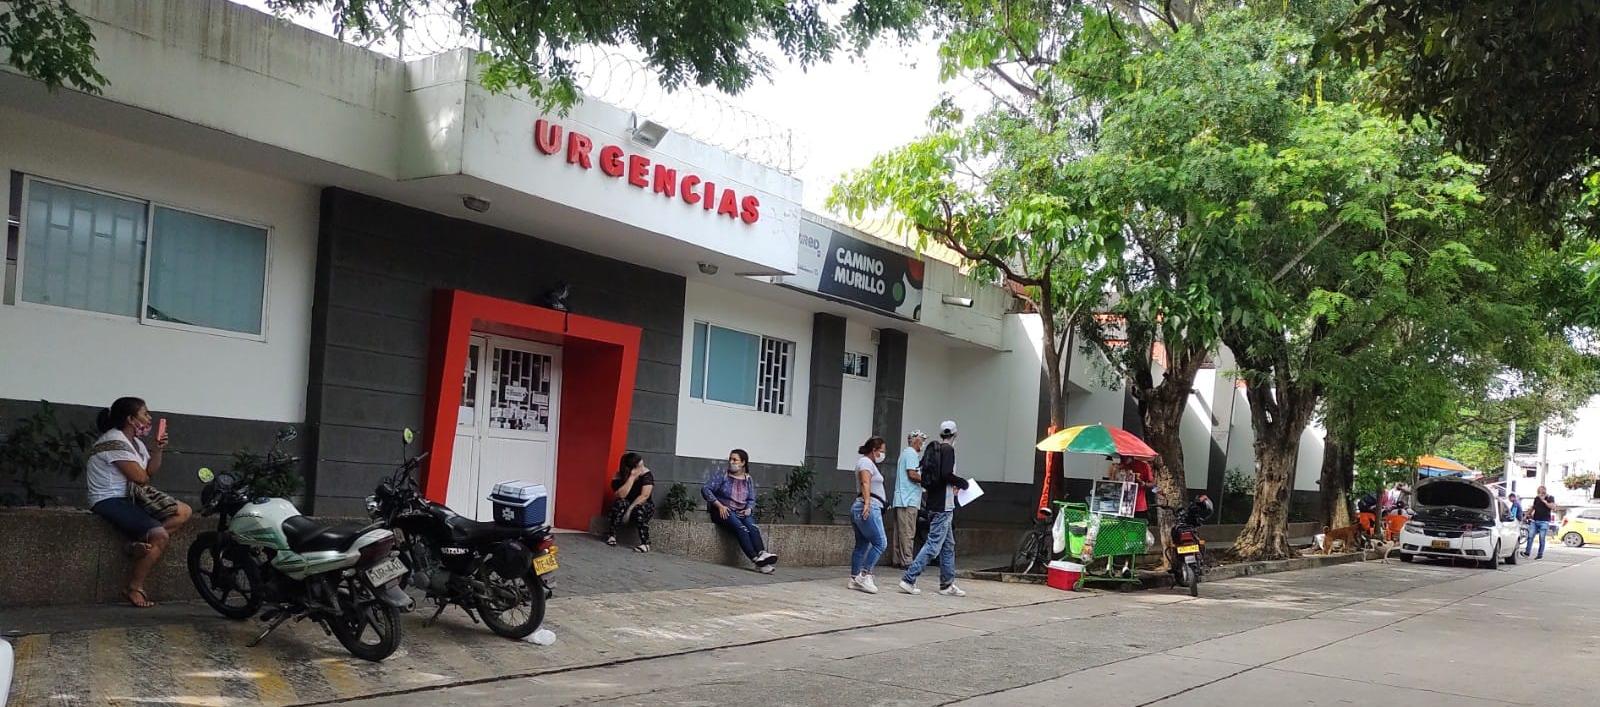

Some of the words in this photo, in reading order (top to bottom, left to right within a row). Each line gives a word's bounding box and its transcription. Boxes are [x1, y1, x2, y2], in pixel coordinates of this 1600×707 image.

[535, 119, 760, 224] URGENCIAS
[836, 247, 884, 276] CAMINO
[834, 266, 886, 295] MURILLO
[440, 546, 469, 555] SUZUKI
